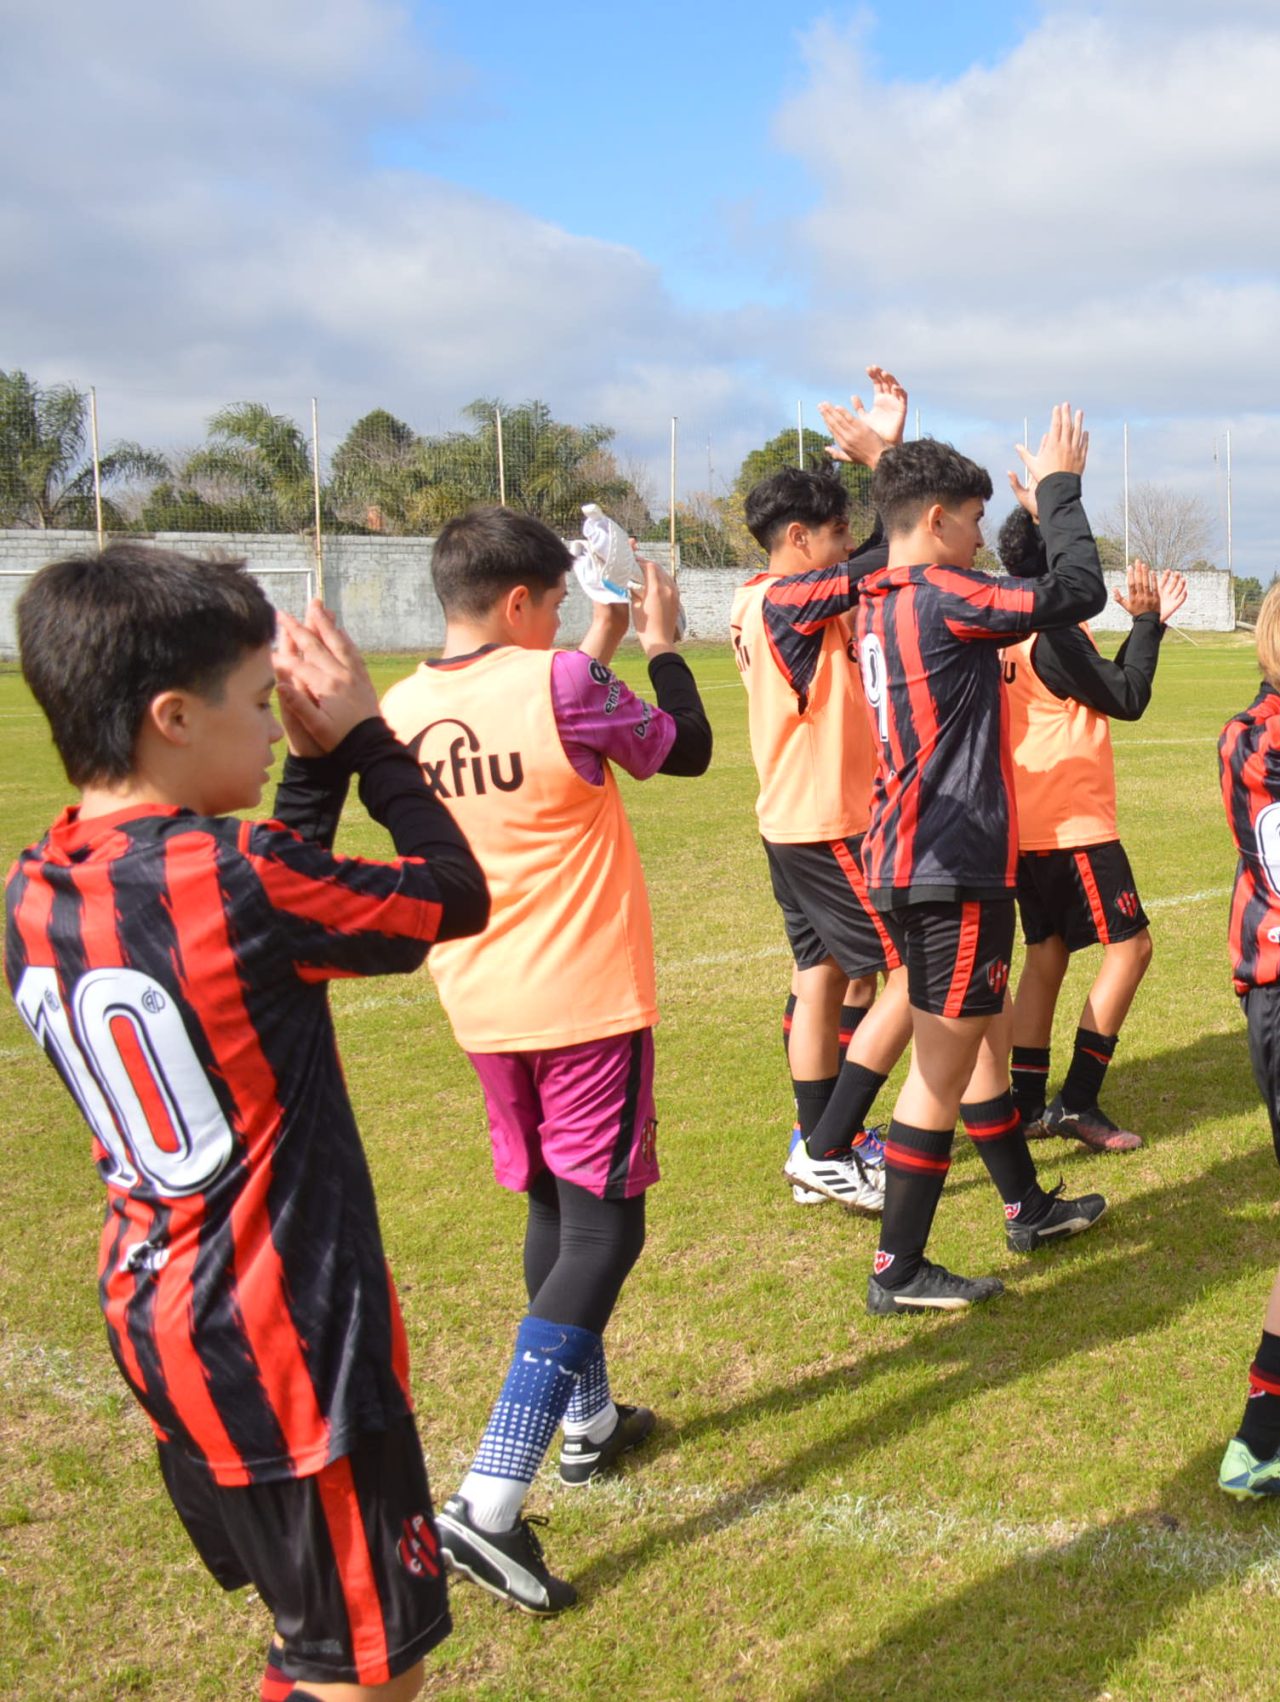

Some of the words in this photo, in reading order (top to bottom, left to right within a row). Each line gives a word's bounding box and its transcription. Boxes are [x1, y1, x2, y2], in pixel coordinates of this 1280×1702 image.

[860, 633, 889, 742] 9
[408, 719, 525, 799] xfiu
[15, 966, 233, 1198] 10
